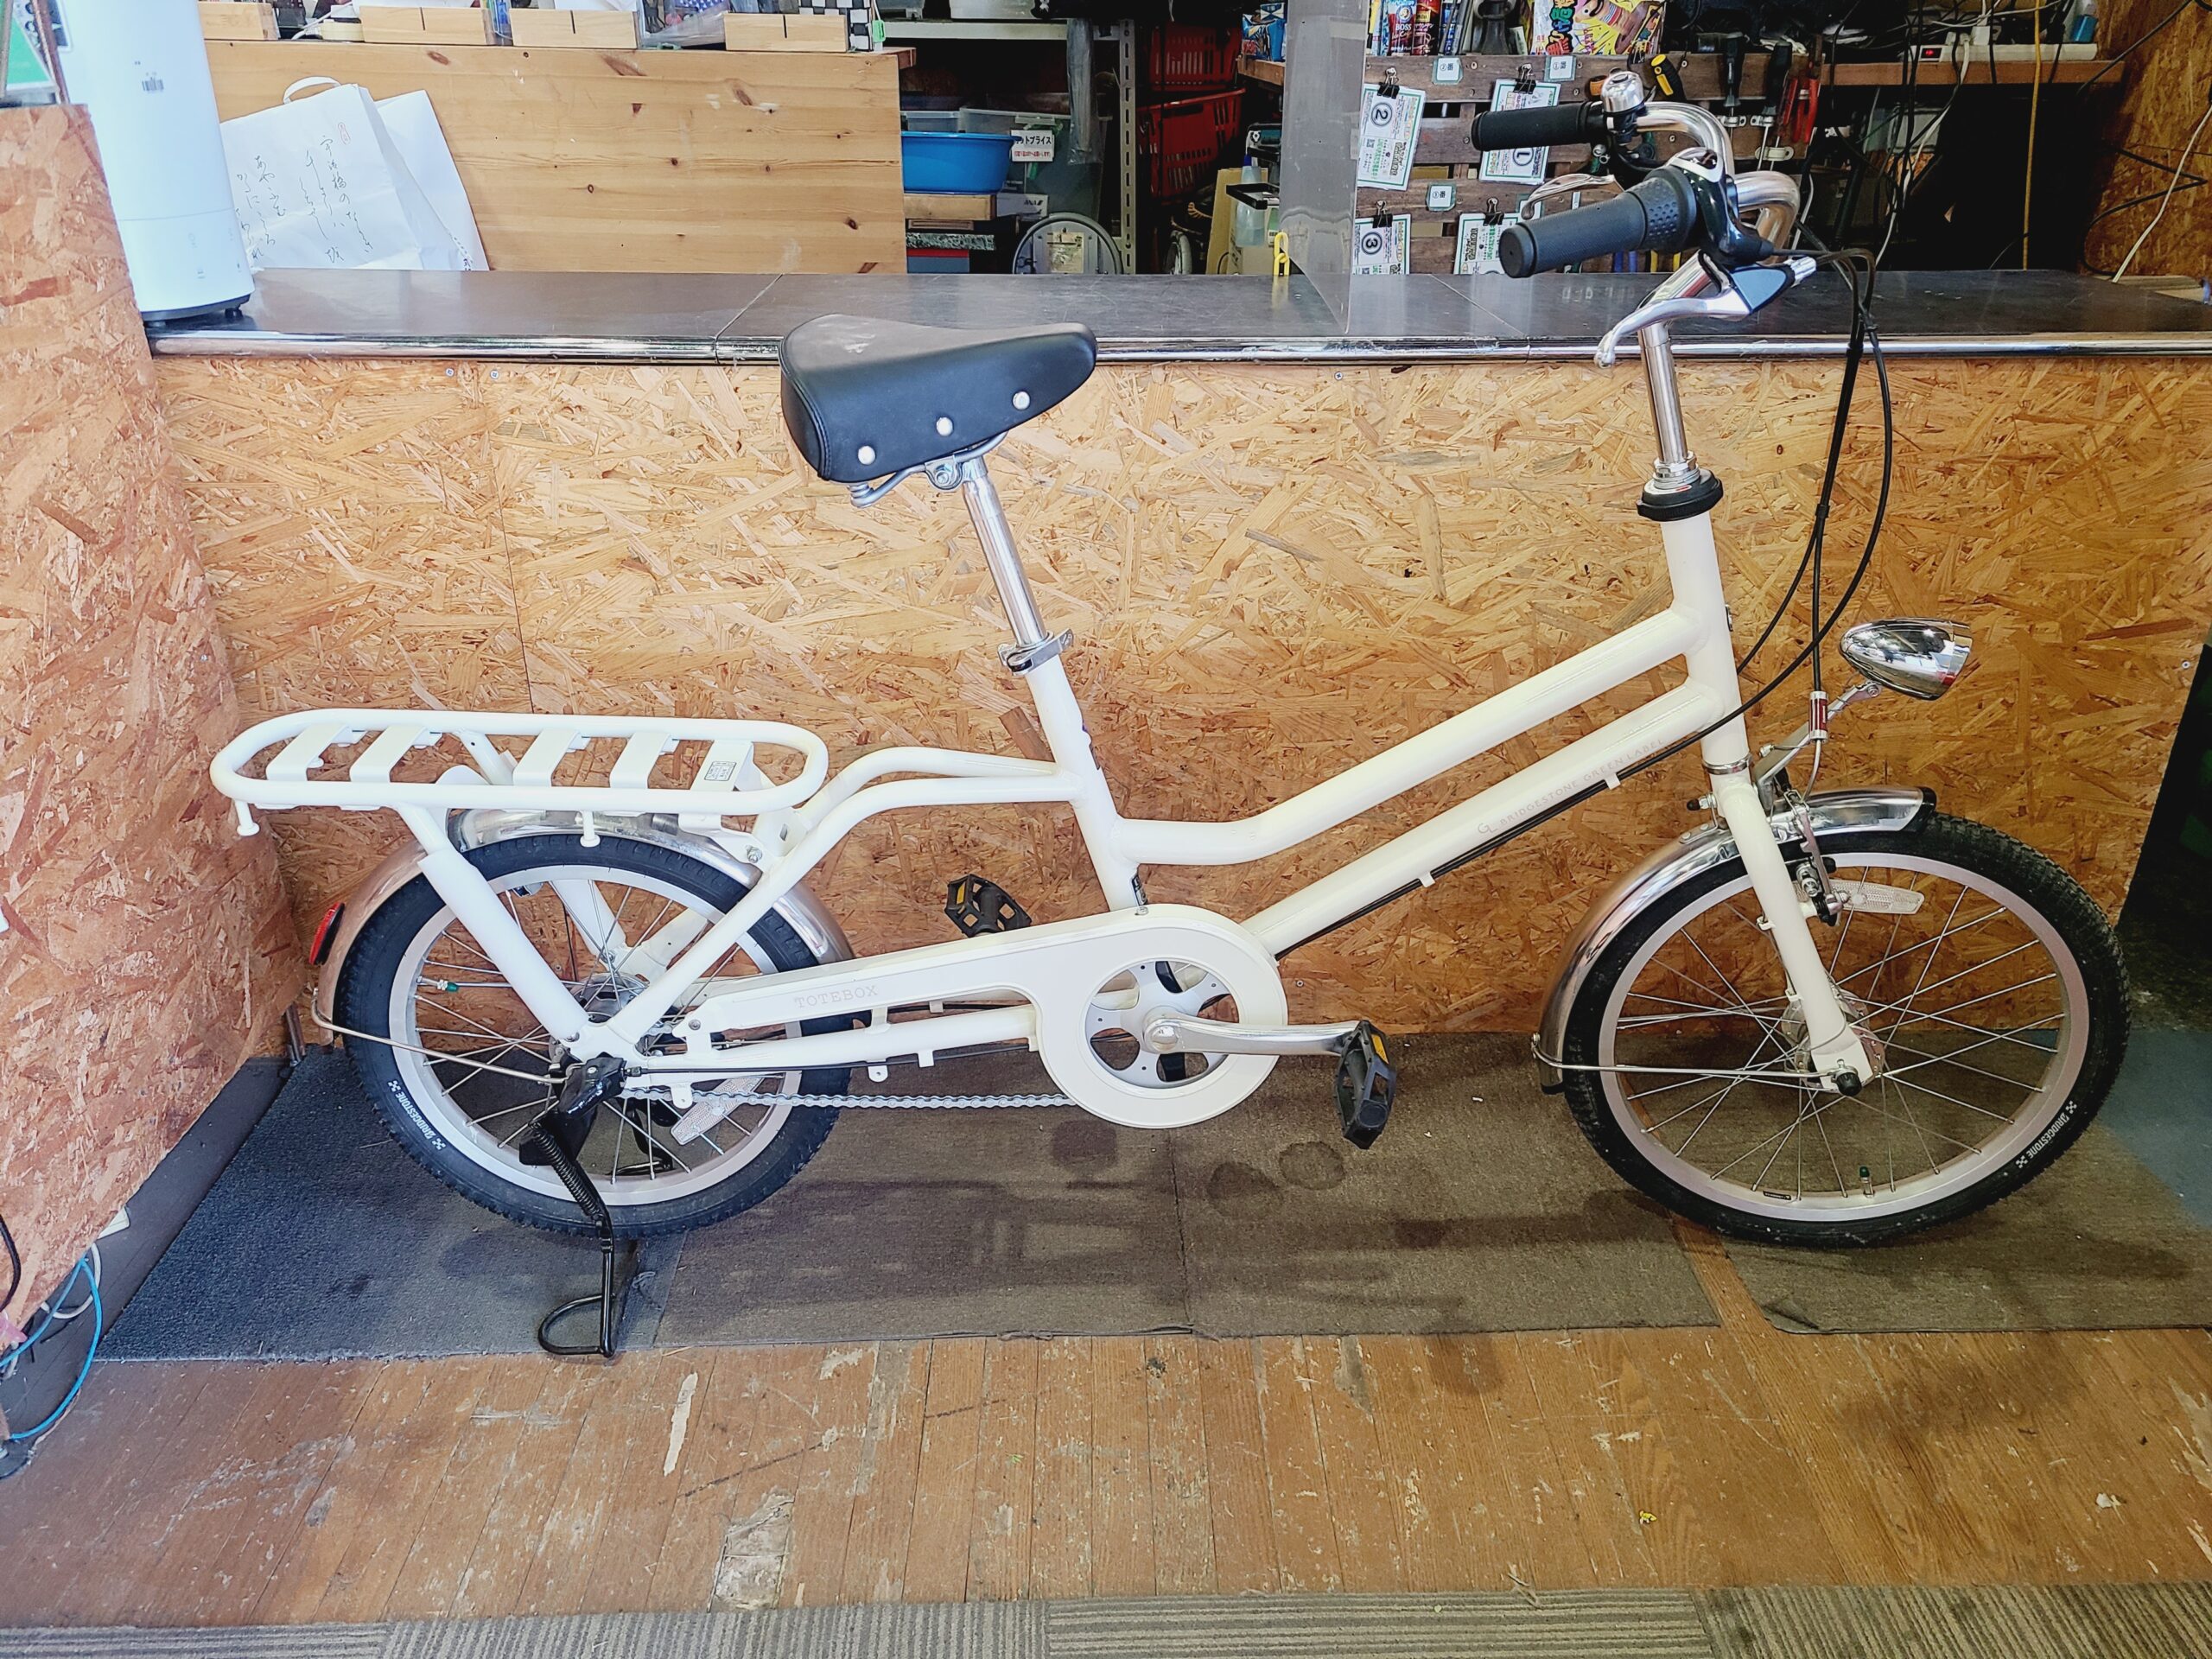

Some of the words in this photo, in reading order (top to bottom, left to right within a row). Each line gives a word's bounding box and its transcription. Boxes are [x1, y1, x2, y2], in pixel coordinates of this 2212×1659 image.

[1500, 779, 1579, 825] BRIDGESTONE
[1583, 757, 1624, 782] GREEN
[1627, 739, 1665, 761] LABEL
[794, 984, 879, 1009] TOTEBOX
[395, 1091, 436, 1140] BRIDGESTONE
[2026, 1112, 2070, 1160] BRIDGESTONE
